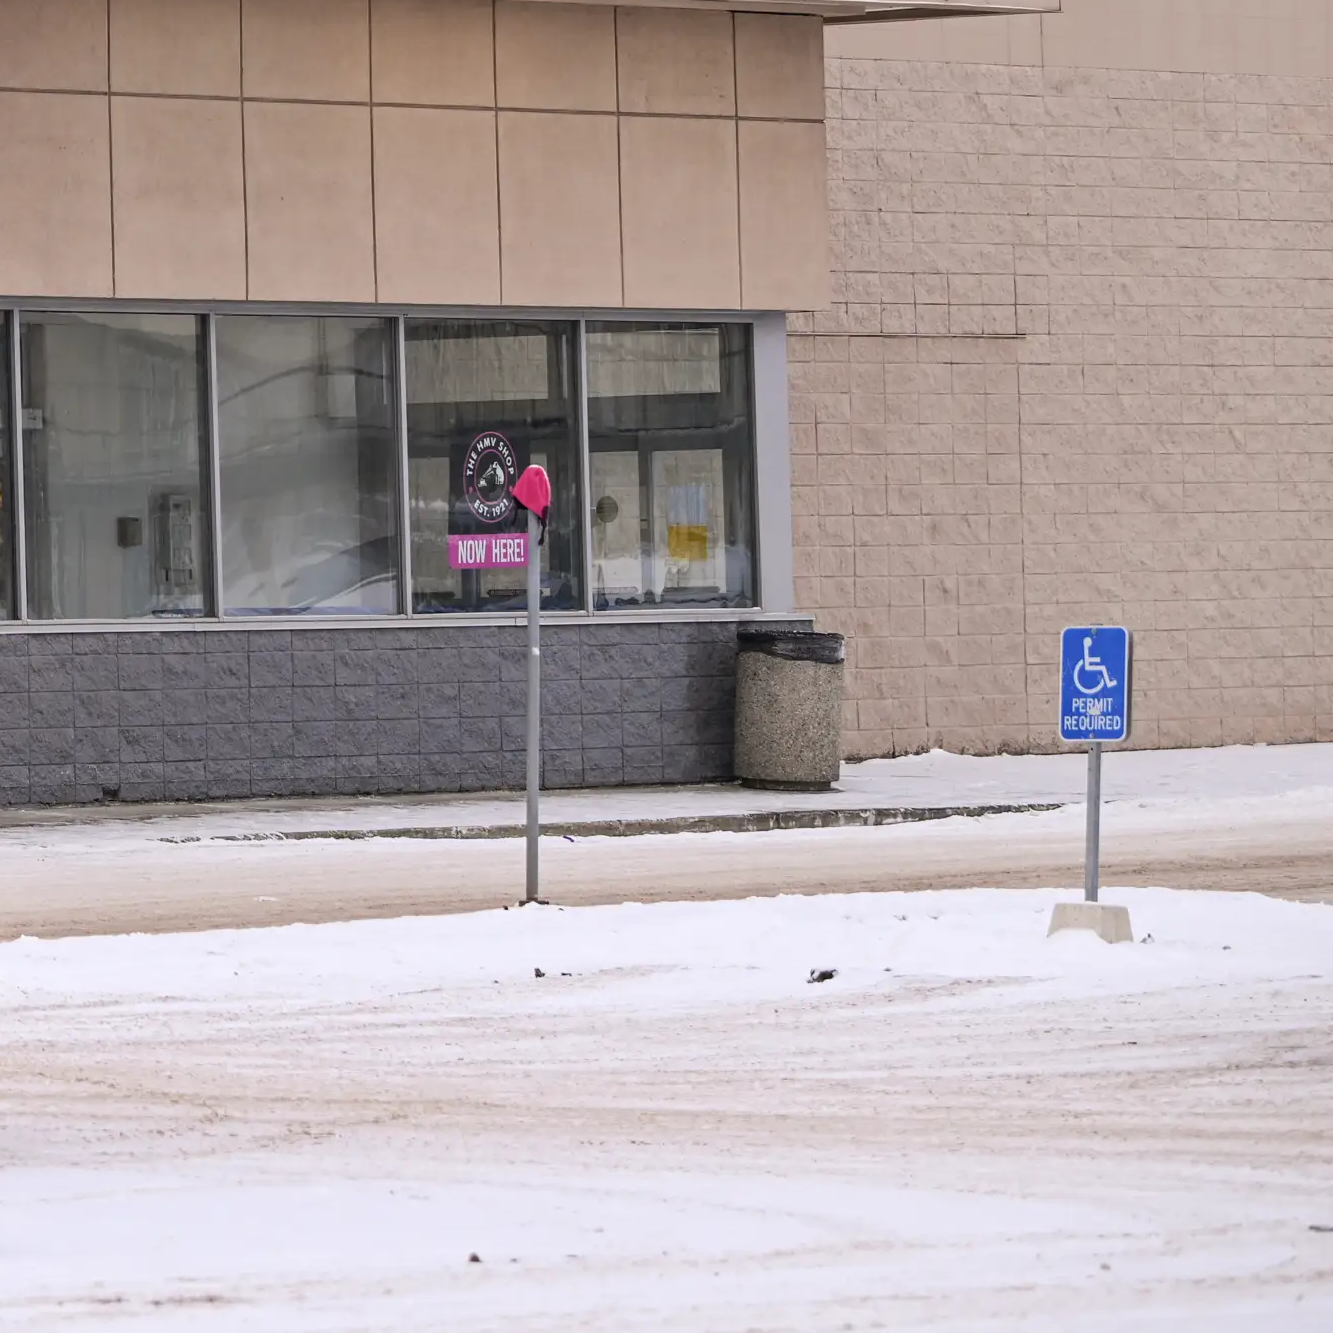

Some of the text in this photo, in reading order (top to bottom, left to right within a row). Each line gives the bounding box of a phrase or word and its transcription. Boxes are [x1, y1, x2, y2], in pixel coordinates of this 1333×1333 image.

[466, 436, 515, 476] THE HMV SHOP
[473, 498, 509, 517] EST. 1921
[458, 538, 525, 564] NOW HERE!
[1071, 697, 1113, 713] PERMIT
[1064, 715, 1121, 731] REQUIRED
